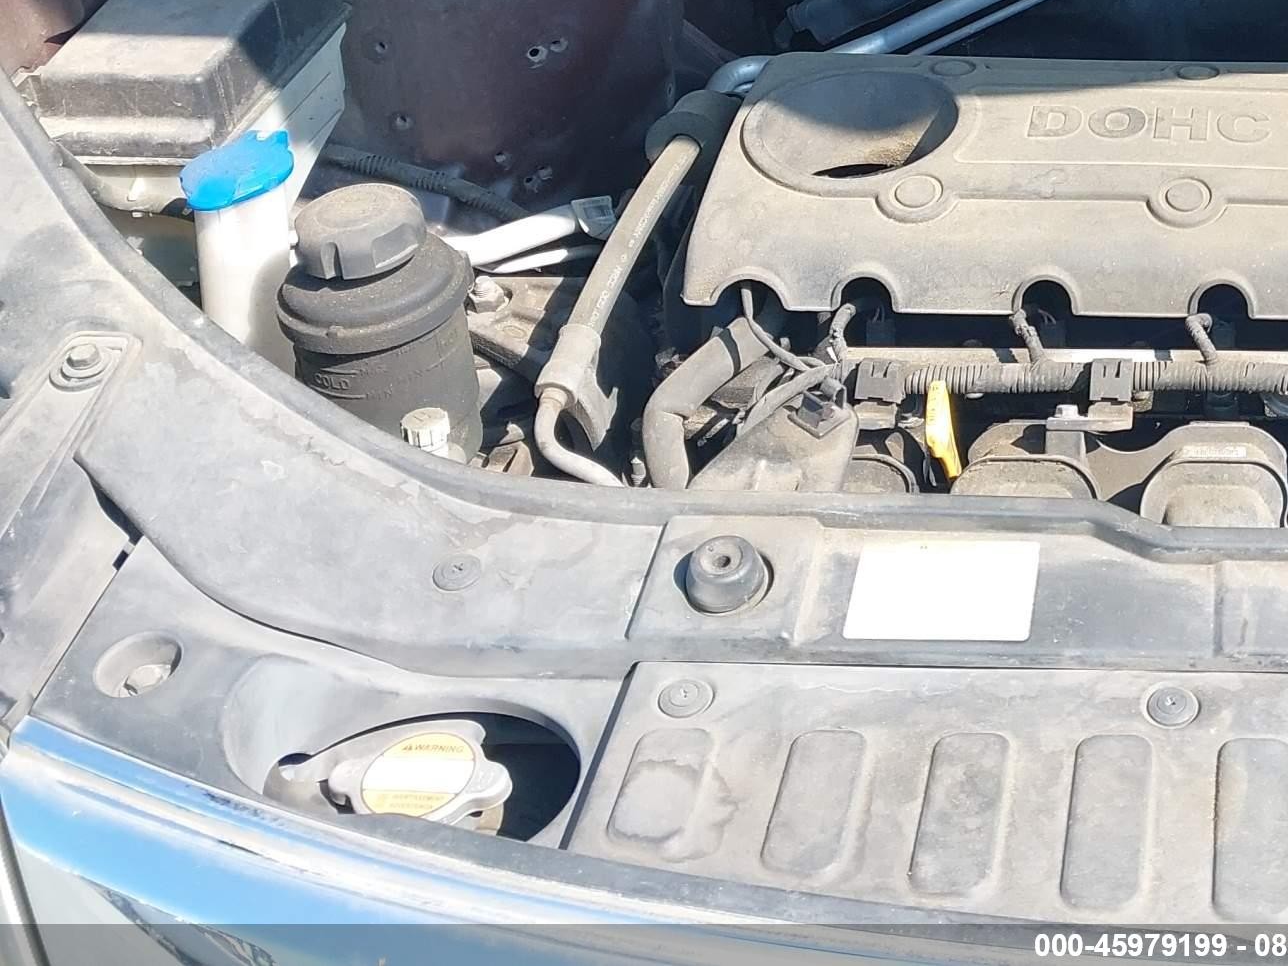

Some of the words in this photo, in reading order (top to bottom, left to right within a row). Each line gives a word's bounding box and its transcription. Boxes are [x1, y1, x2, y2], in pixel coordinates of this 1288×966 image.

[1027, 105, 1270, 144] DOHC
[314, 372, 350, 390] COLD
[415, 744, 464, 753] WARNING
